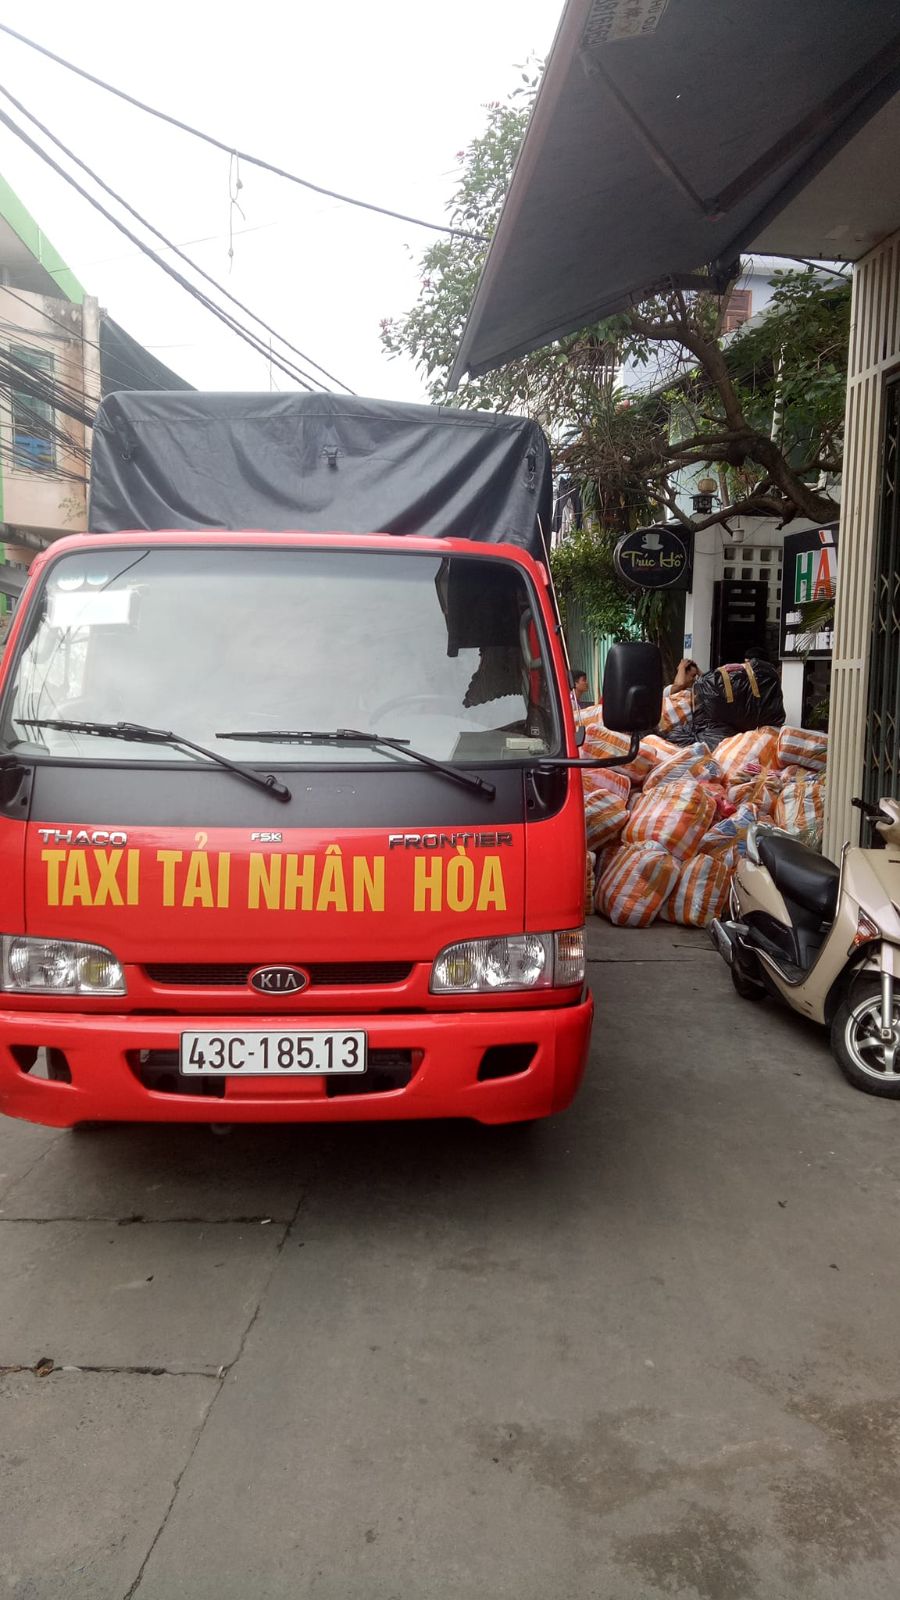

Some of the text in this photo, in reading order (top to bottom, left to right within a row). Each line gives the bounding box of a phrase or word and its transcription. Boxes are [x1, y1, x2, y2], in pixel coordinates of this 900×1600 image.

[621, 551, 656, 568] Trúc
[38, 829, 128, 847] THACO
[251, 832, 283, 842] FSK
[389, 832, 513, 849] FRONTIER
[41, 831, 507, 912] TAXI TẢI NHÂN HÒA
[261, 973, 298, 988] KIA
[189, 1036, 359, 1069] 43C-185.13
